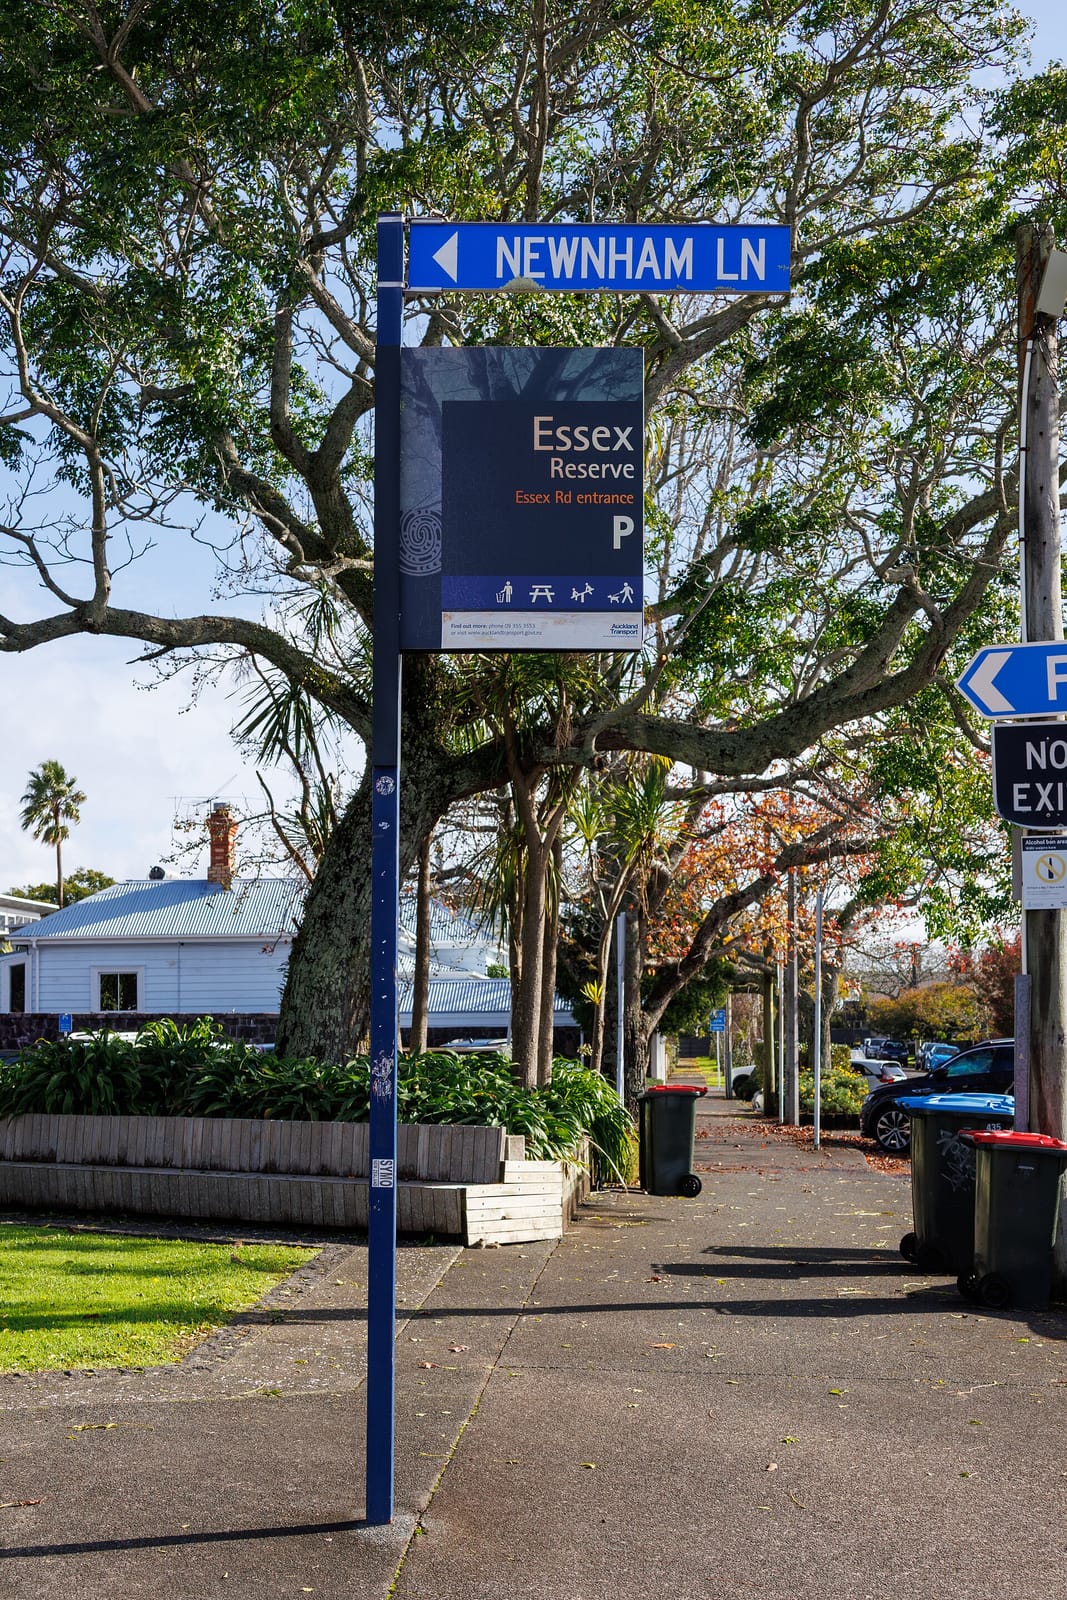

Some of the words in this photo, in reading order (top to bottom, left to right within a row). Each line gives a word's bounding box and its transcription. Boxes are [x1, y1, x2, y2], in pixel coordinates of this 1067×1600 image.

[496, 236, 693, 280] NEWNHAM
[716, 237, 766, 281] LN
[533, 416, 635, 452] Essex
[550, 457, 635, 479] Reserve
[515, 490, 551, 504] Essex
[555, 490, 572, 504] Rd
[576, 491, 634, 504] entrance
[613, 515, 635, 550] P
[1025, 740, 1067, 770] NO
[1013, 782, 1067, 812] EXI
[379, 1160, 392, 1186] SYMO
